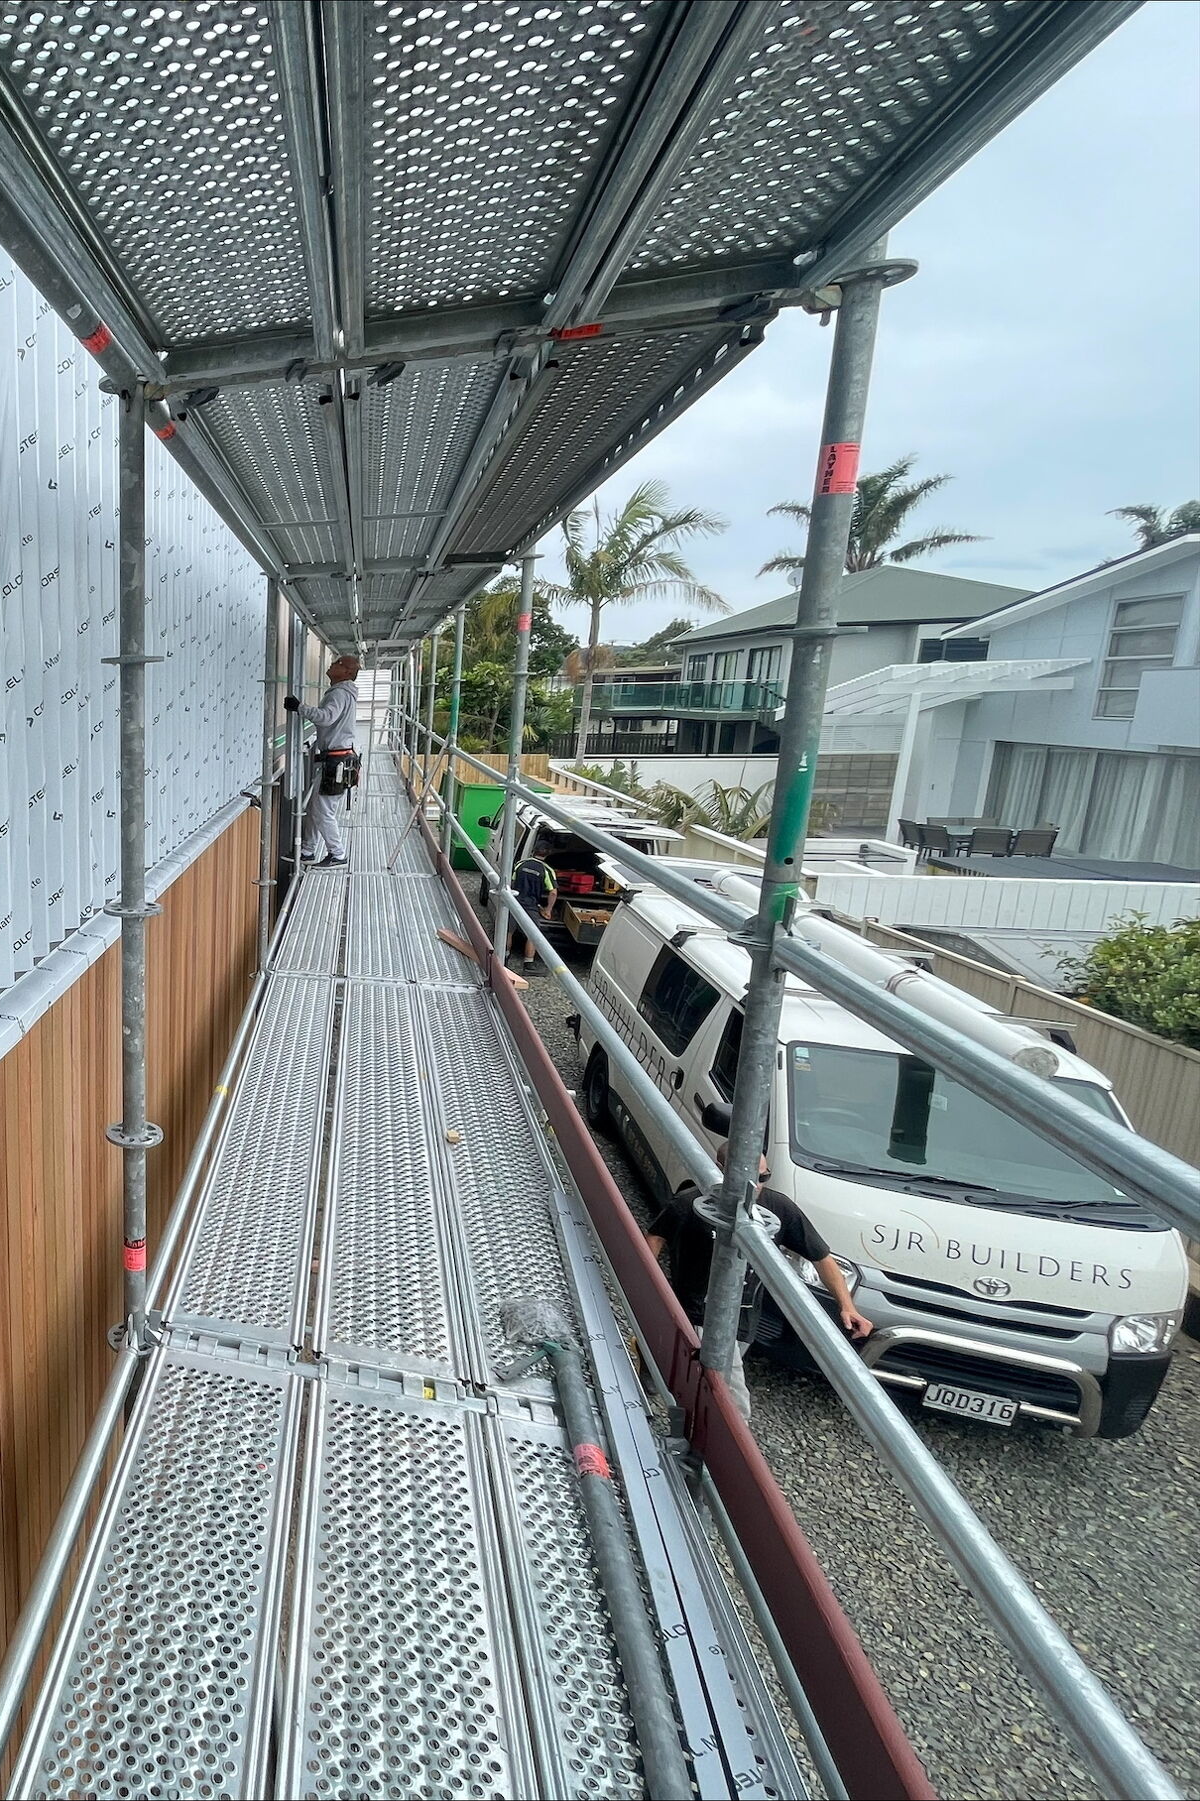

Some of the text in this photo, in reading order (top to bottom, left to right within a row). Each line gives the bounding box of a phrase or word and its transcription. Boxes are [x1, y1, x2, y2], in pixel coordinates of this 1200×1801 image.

[872, 1223, 1134, 1291] SJR BUILDERS
[926, 1387, 1015, 1421] JQD316
